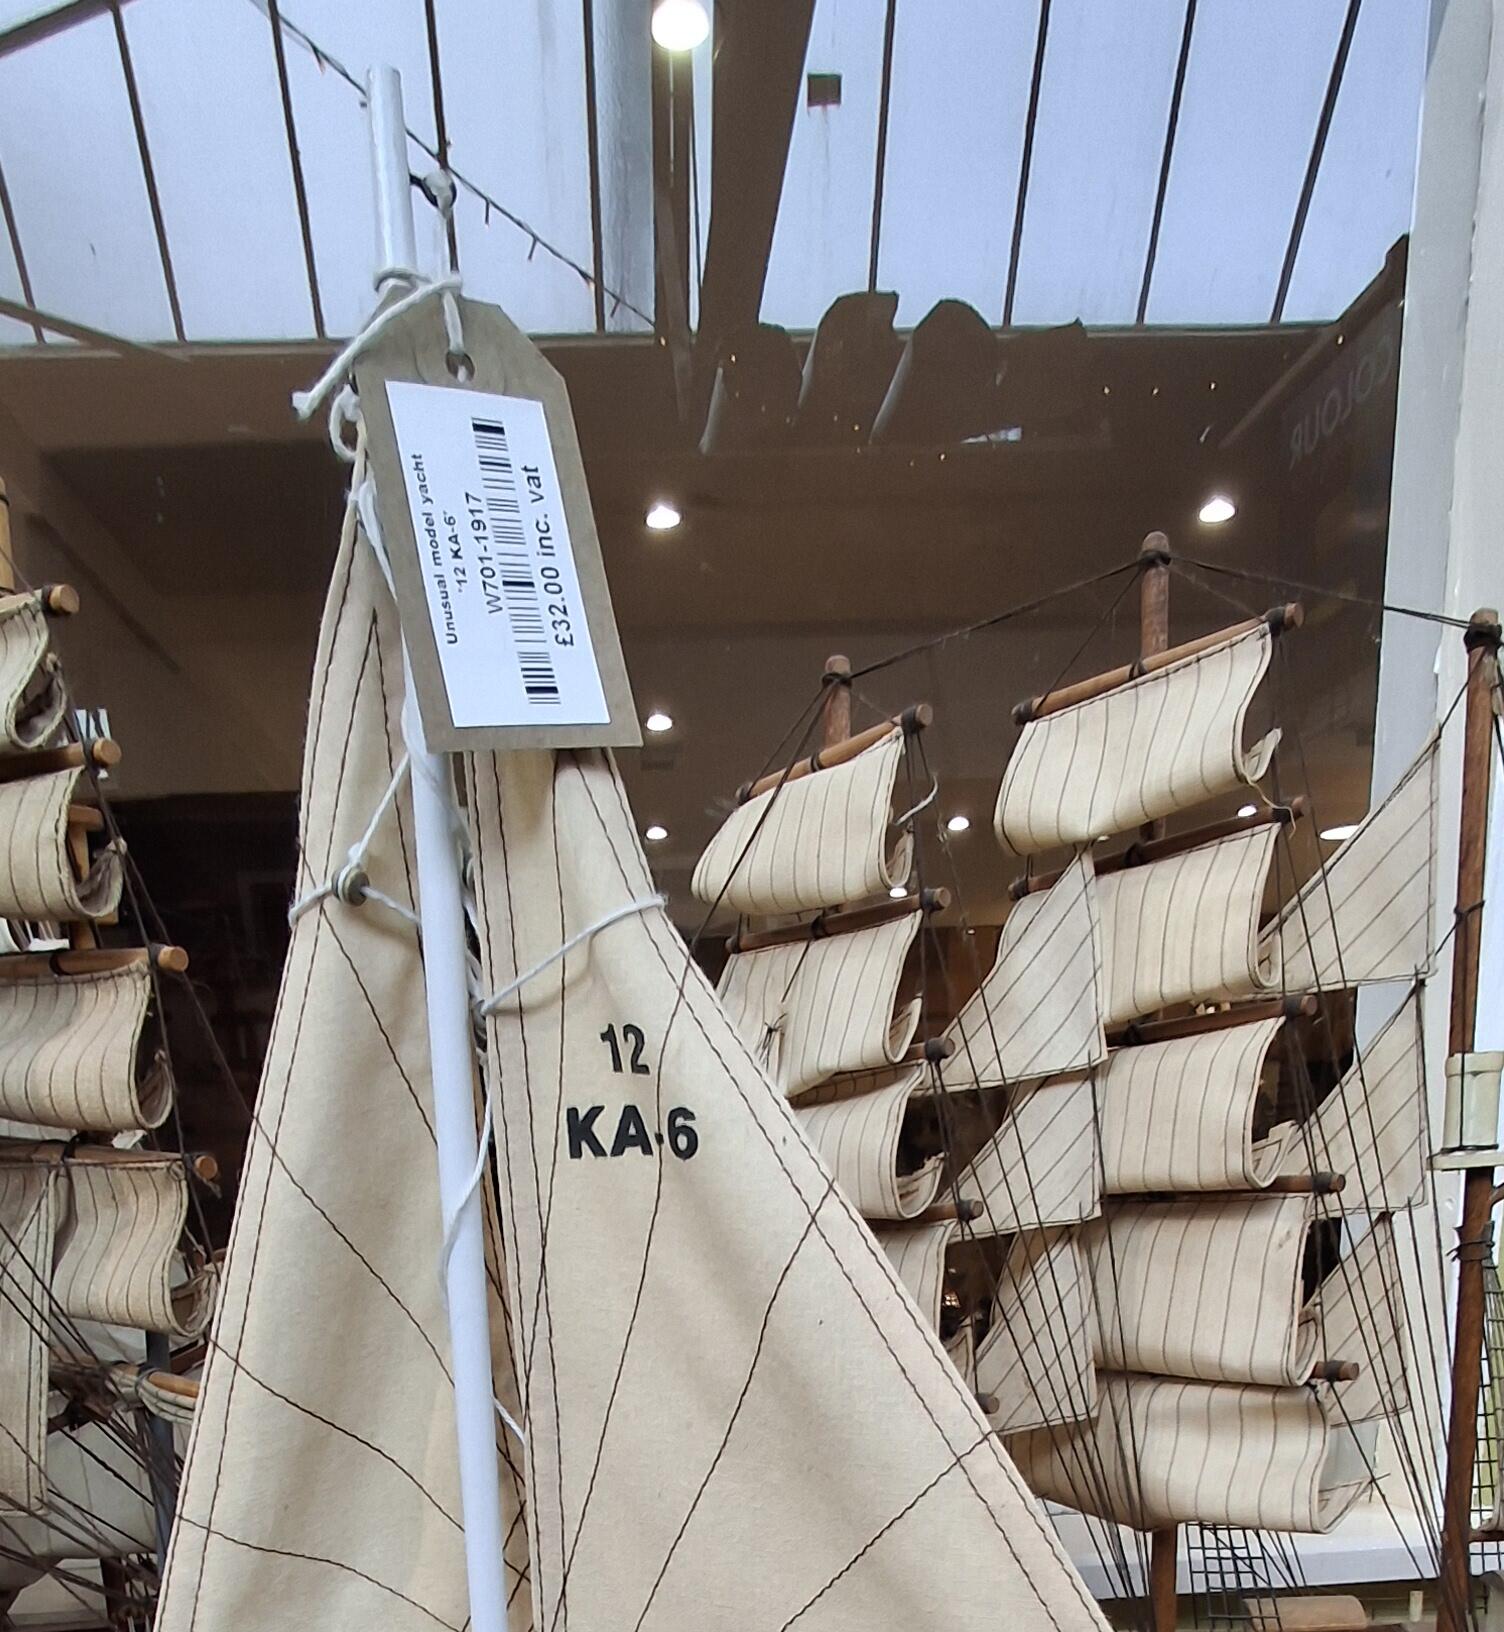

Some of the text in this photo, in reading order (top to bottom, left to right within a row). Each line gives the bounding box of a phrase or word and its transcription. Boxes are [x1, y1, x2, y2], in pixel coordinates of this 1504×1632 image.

[411, 453, 459, 645] Unusual model yacht
[465, 491, 503, 614] W701-1917
[521, 465, 575, 647] £32.00 inc. vat
[600, 1023, 650, 1075] 12
